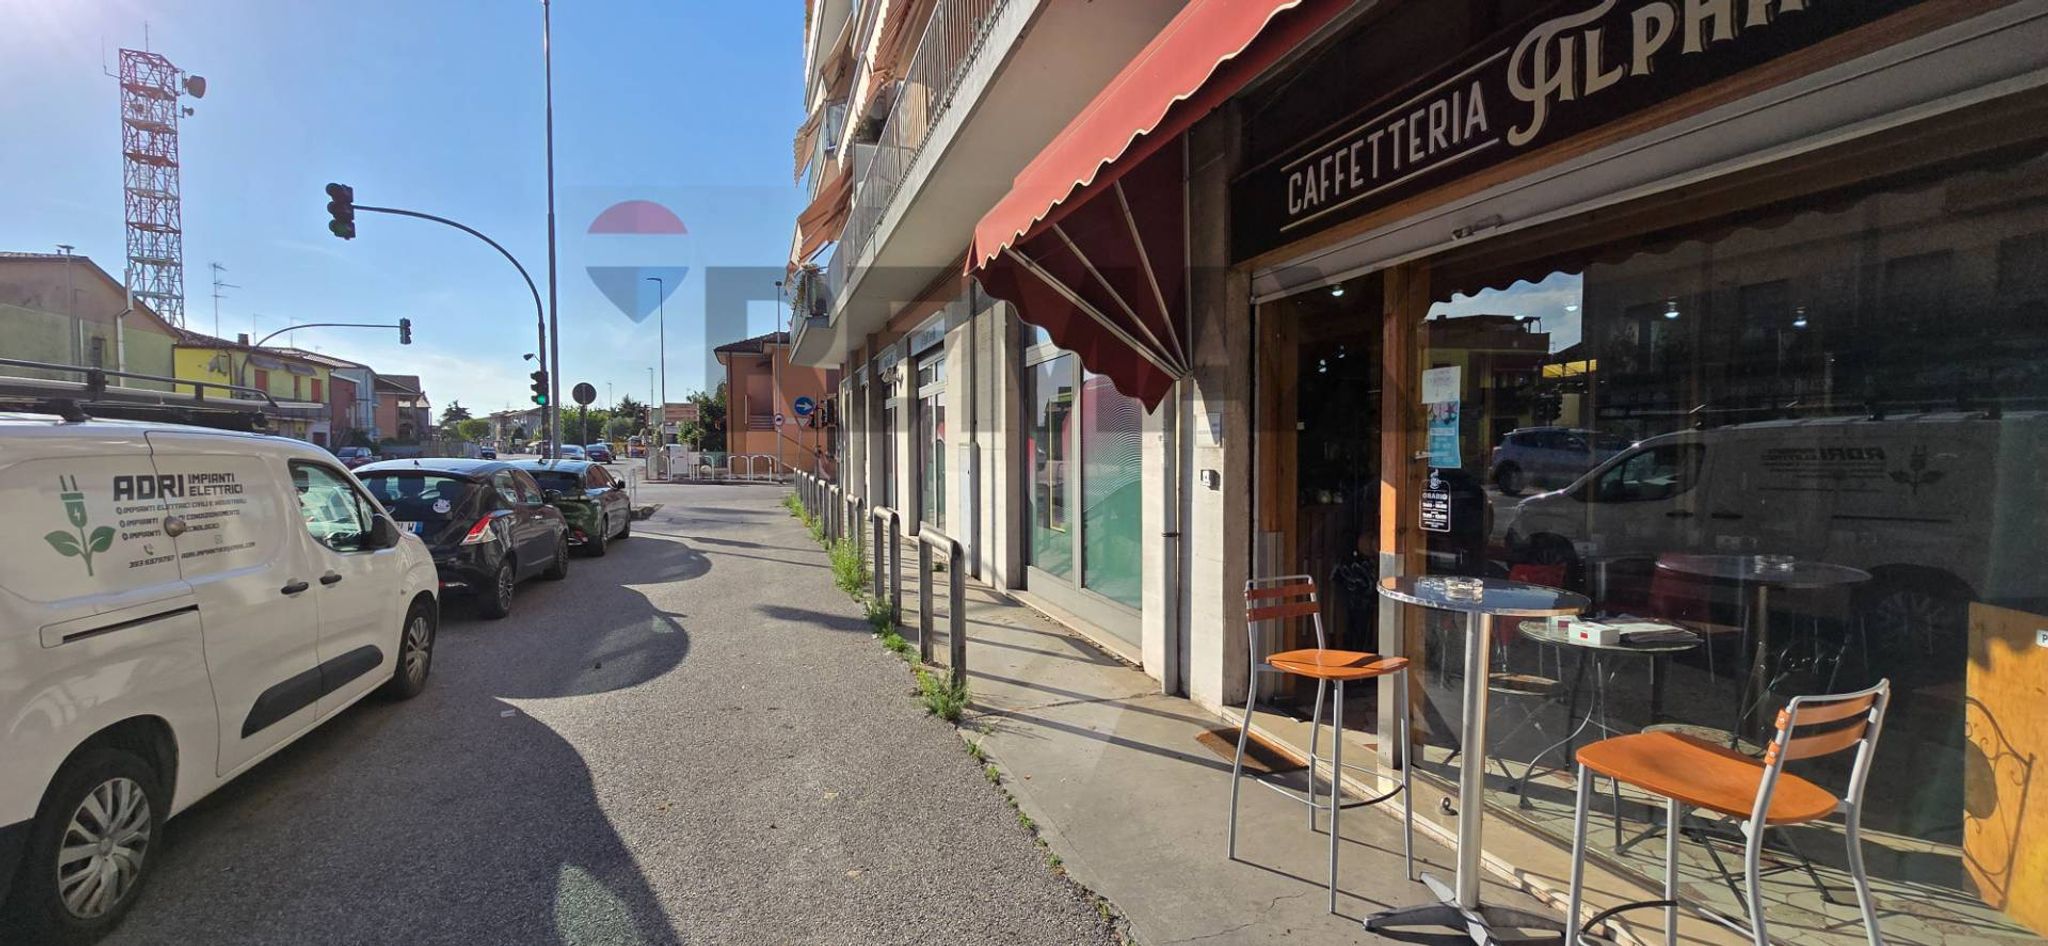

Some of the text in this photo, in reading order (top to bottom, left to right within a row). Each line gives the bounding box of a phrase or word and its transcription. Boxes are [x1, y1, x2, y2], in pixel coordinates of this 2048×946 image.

[1288, 0, 1808, 216] CAFFETTERIA ALPH
[113, 474, 186, 501] ADRI
[188, 473, 236, 484] IMPIANTI
[189, 484, 244, 496] ELETTRICI
